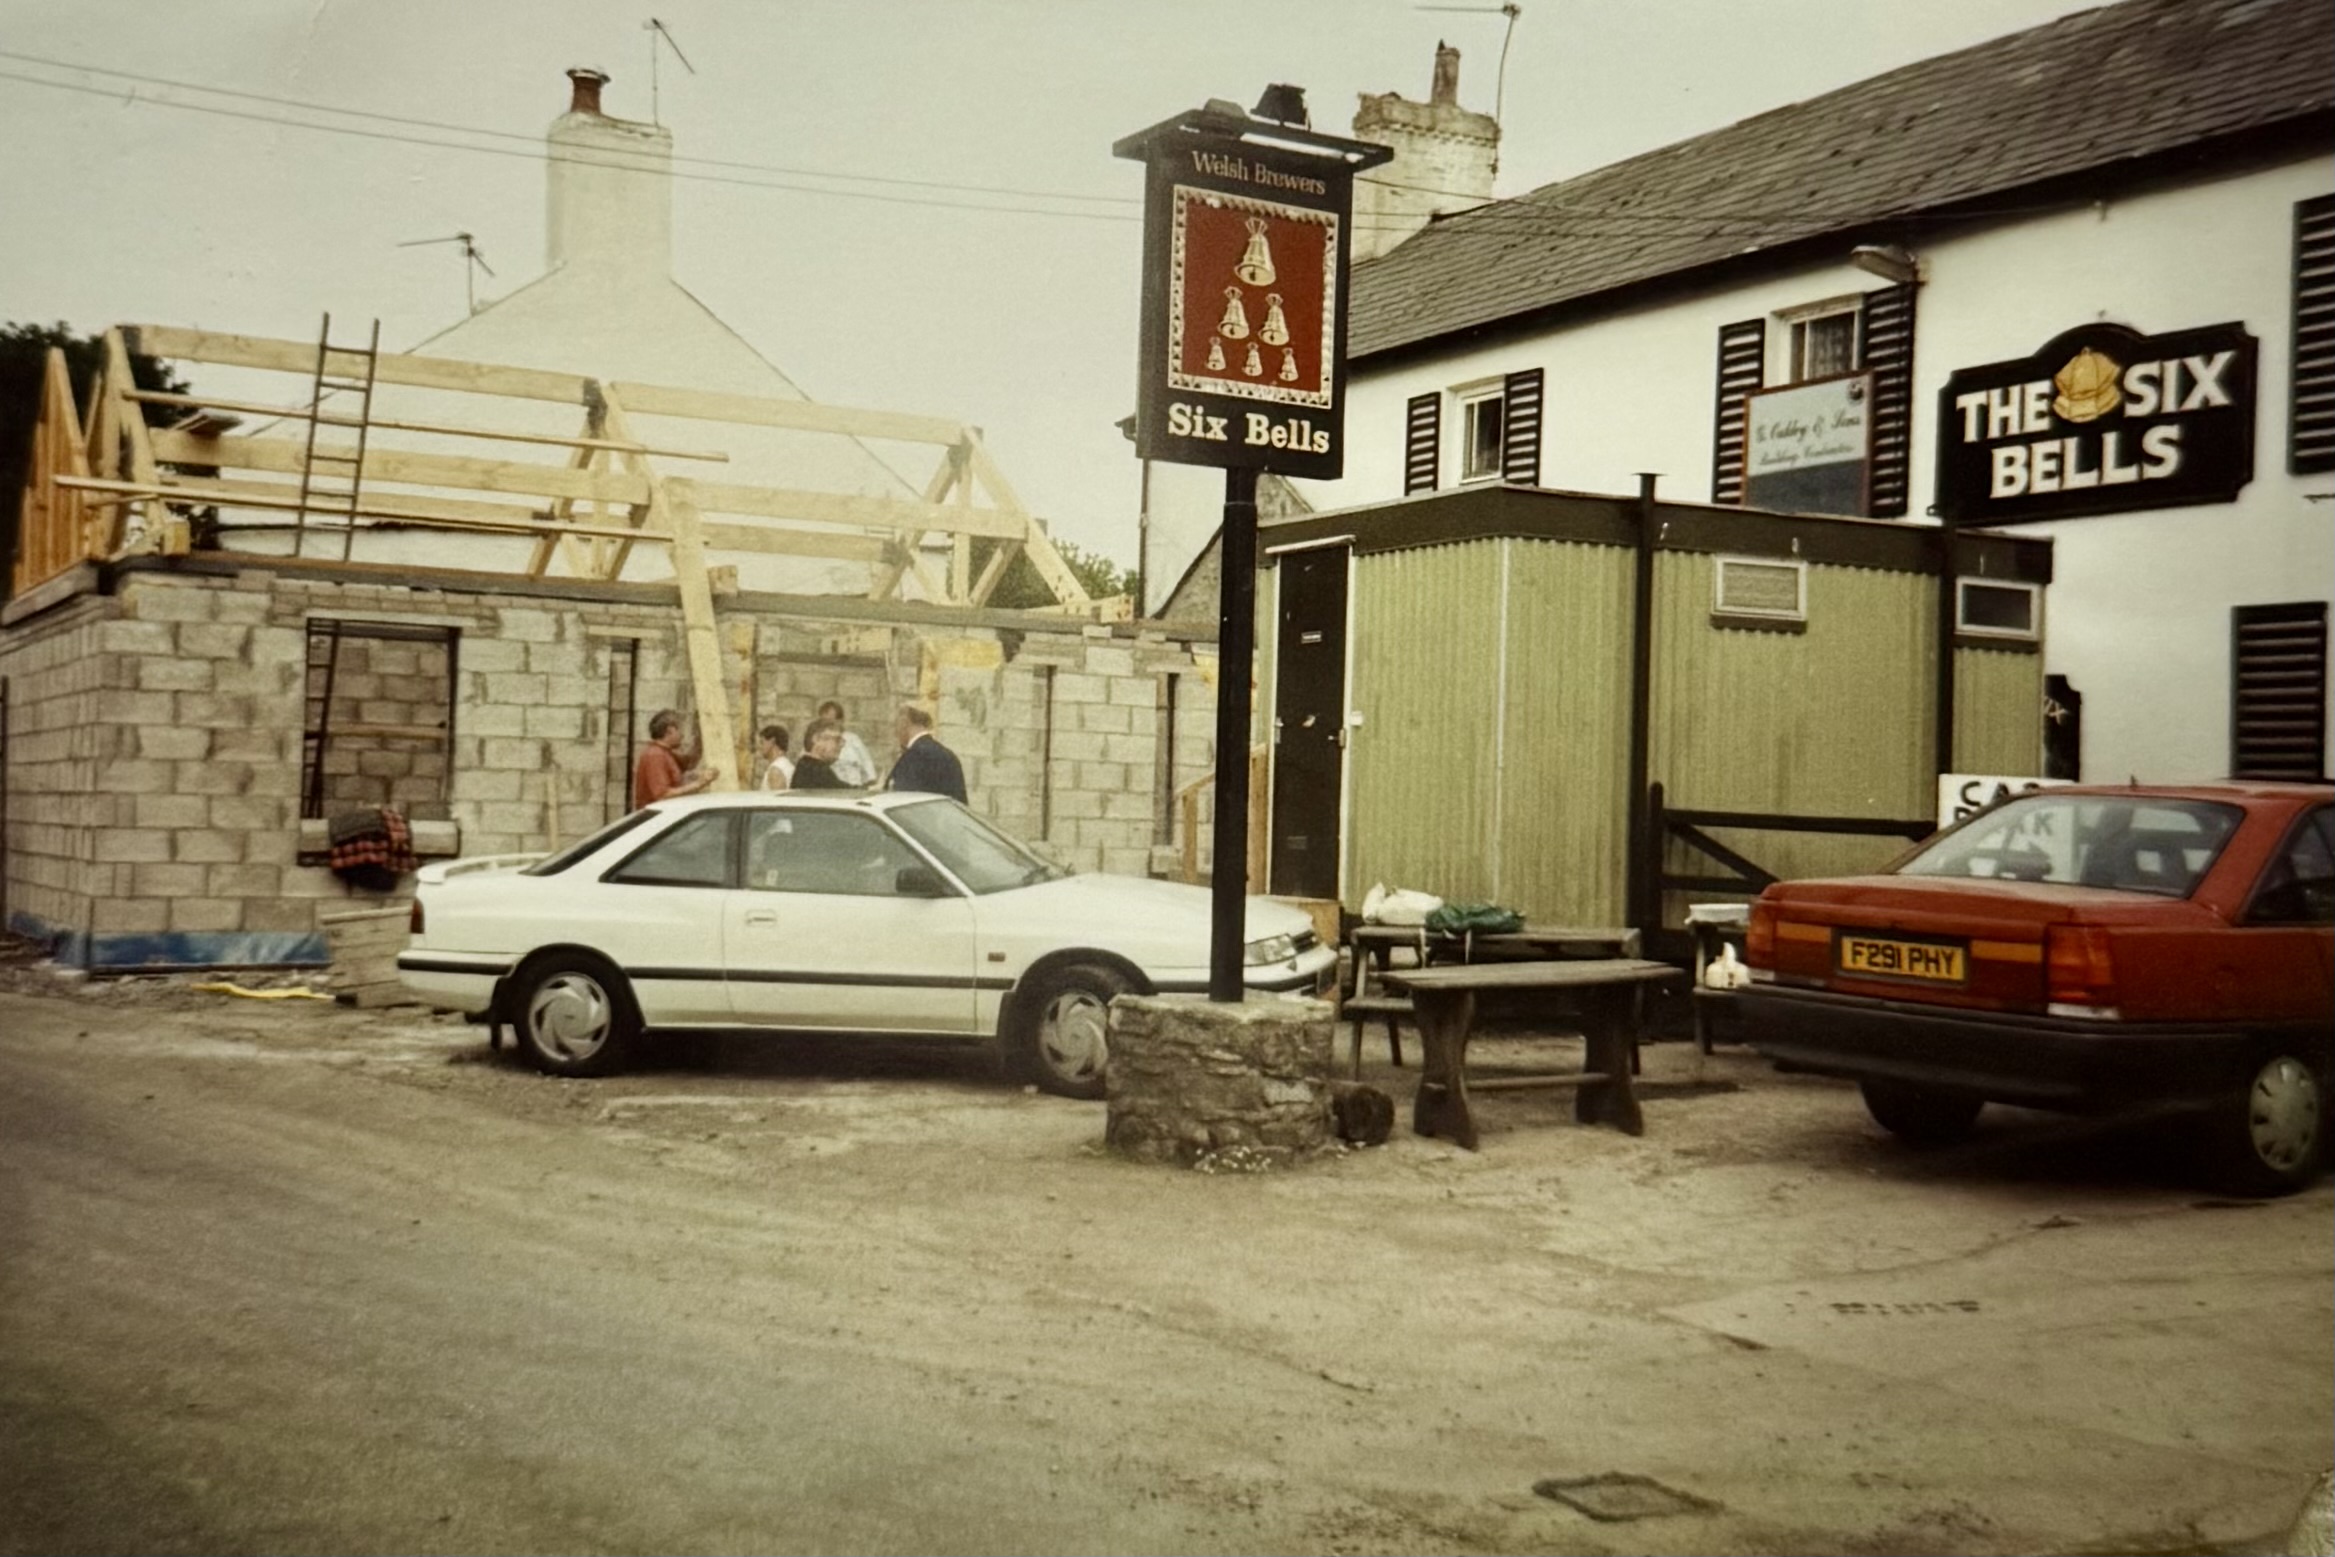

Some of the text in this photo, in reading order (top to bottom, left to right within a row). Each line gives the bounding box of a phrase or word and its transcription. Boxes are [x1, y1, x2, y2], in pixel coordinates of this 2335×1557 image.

[1192, 151, 1326, 196] Welsh Brewers
[1956, 351, 2237, 443] THE SIX
[1168, 402, 1330, 454] Six Bells
[1990, 424, 2180, 499] BELLS
[1960, 780, 2041, 808] CA
[1851, 941, 1955, 975] F291 PHY
